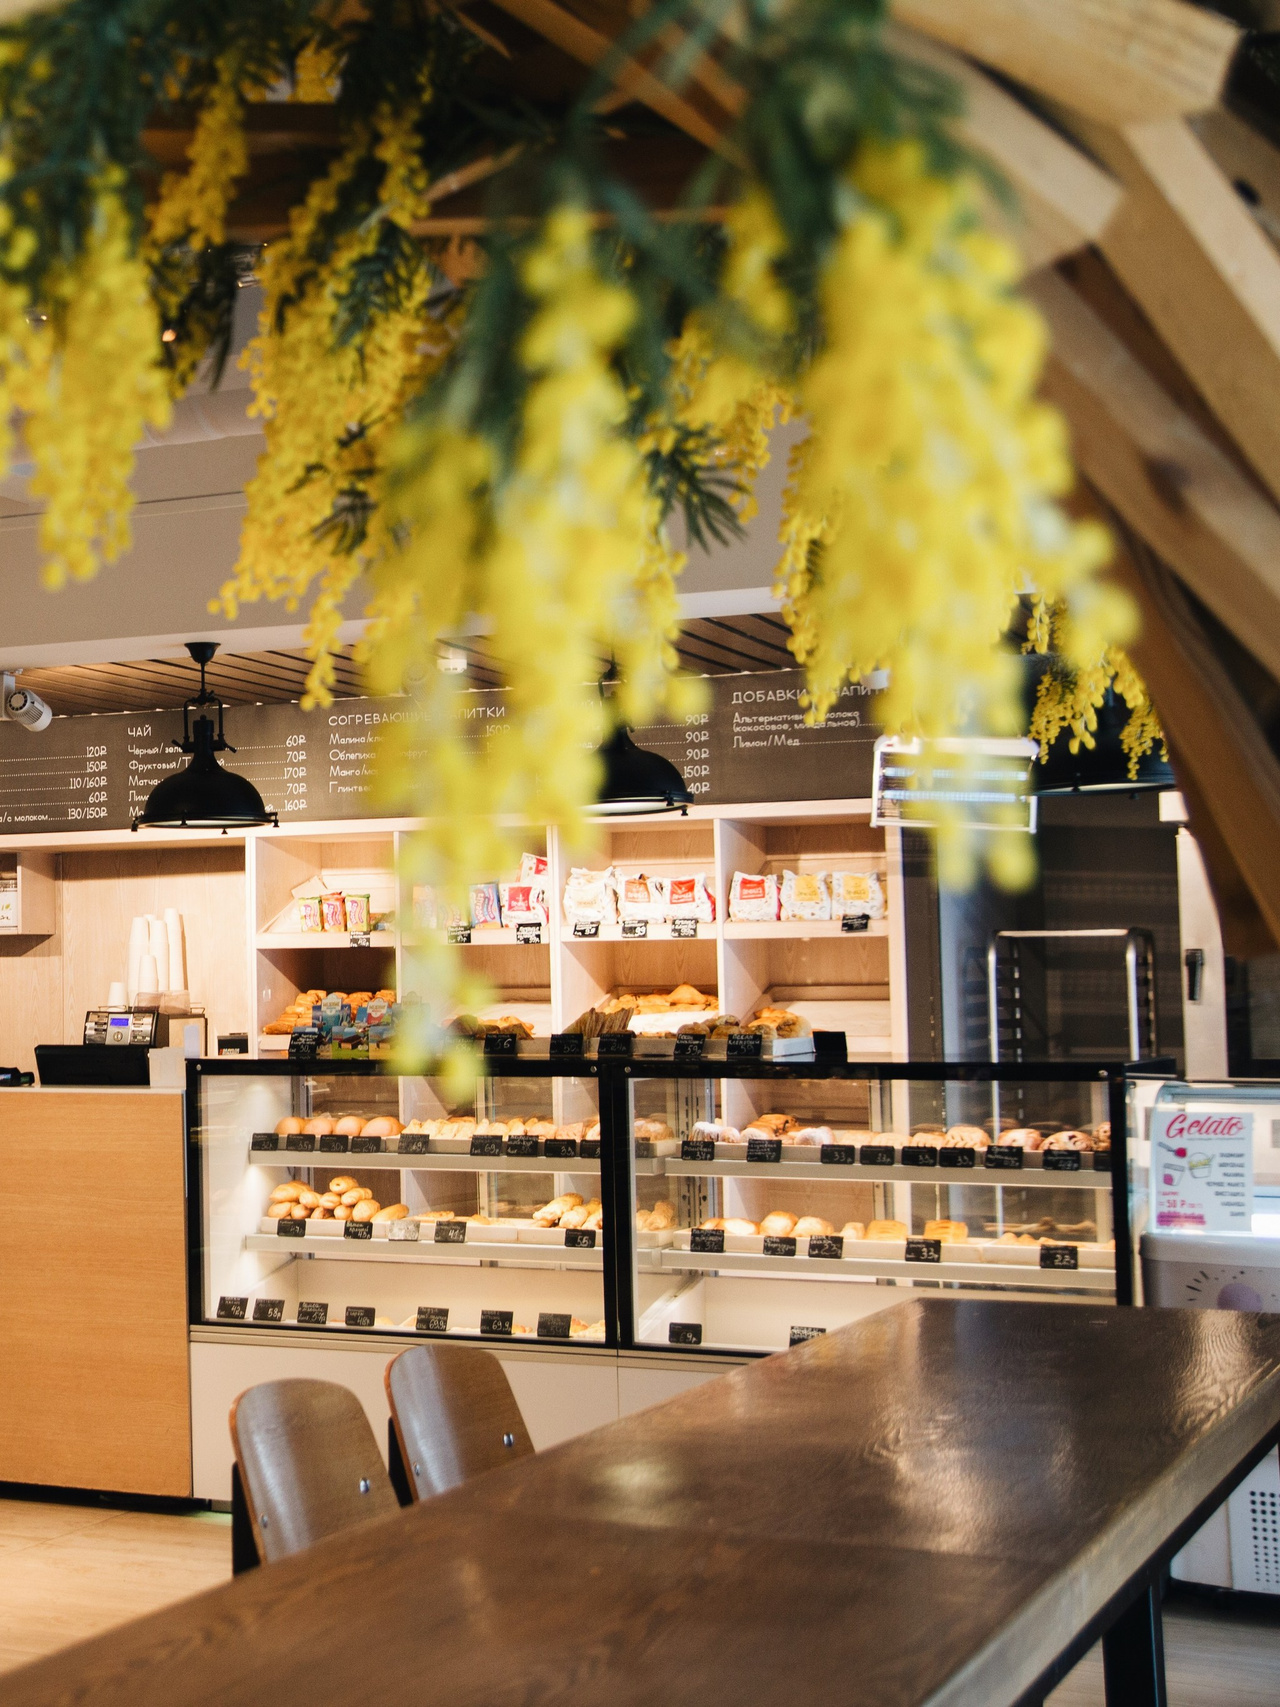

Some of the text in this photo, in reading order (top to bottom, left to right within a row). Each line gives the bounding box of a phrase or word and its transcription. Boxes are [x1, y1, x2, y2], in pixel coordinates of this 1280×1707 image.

[731, 688, 807, 705] ДОБАВКИ
[732, 711, 805, 727] Альтернативн
[127, 724, 152, 737] ЧАЙ
[732, 722, 792, 733] (кокосовое,
[14, 813, 49, 822] молоком
[1165, 1113, 1247, 1139] Gelato
